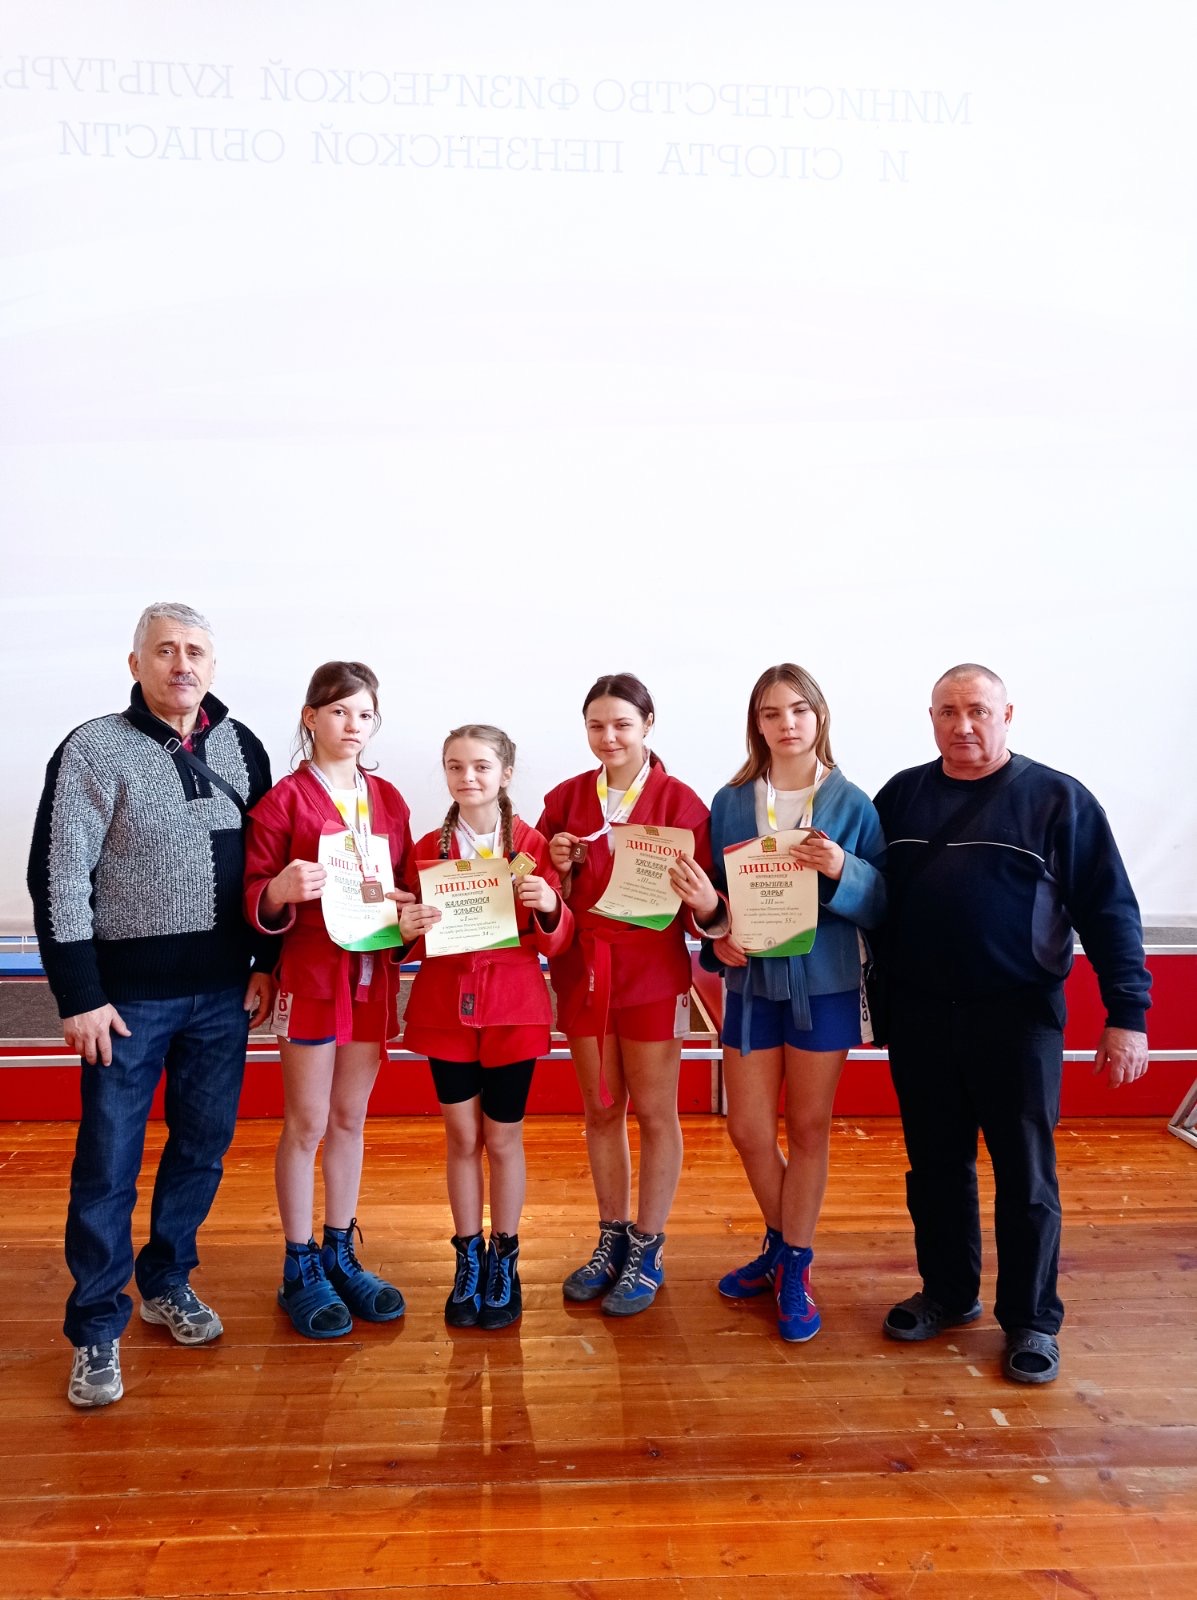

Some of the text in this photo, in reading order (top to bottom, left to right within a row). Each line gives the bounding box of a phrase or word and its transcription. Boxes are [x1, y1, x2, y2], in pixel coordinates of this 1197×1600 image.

[625, 840, 683, 858] ДИПЛОМ
[738, 861, 804, 876] ДИПЛОМ
[434, 877, 500, 896] ДИПЛОМ
